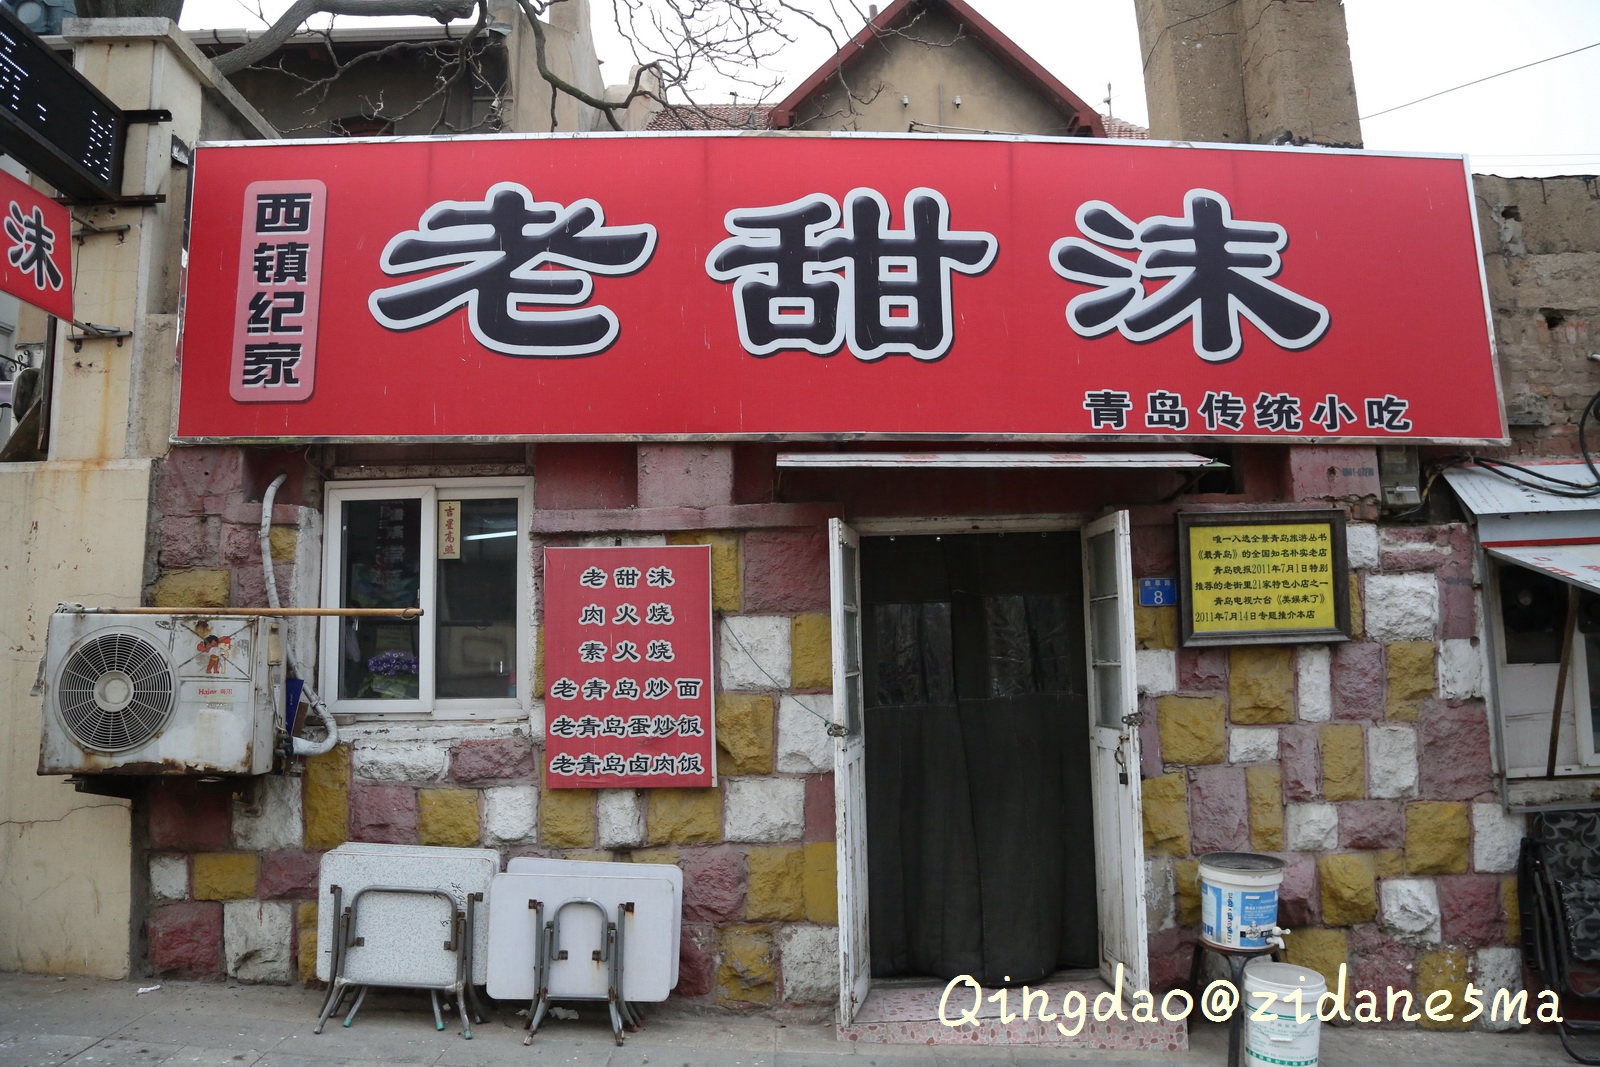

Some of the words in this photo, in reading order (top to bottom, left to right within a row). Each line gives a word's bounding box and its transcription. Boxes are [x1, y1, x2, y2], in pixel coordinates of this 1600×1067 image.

[4, 200, 63, 291] 沫
[367, 183, 1331, 362] 老甜沫
[242, 193, 313, 388] 西镇纪家
[1083, 389, 1412, 432] 青岛传统小吃
[443, 506, 456, 555] 吉星高照
[1212, 533, 1328, 544] 唯一入选全景青岛旅游丛书
[580, 566, 675, 588] 老甜沫
[1213, 564, 1328, 575] 青岛晚报2011年7月1日特别
[1195, 579, 1329, 591] 推荐的老街里21家特色小店之一
[1154, 590, 1163, 605] 8
[578, 603, 675, 626] 肉火烧
[1195, 609, 1315, 623] 2011年7月14日专题推介本店
[578, 640, 675, 663] 素火烧
[550, 677, 703, 700] 老青岛炒面
[550, 715, 704, 739] 老青岛蛋炒饭
[550, 752, 705, 777] 老青岛卤肉饭
